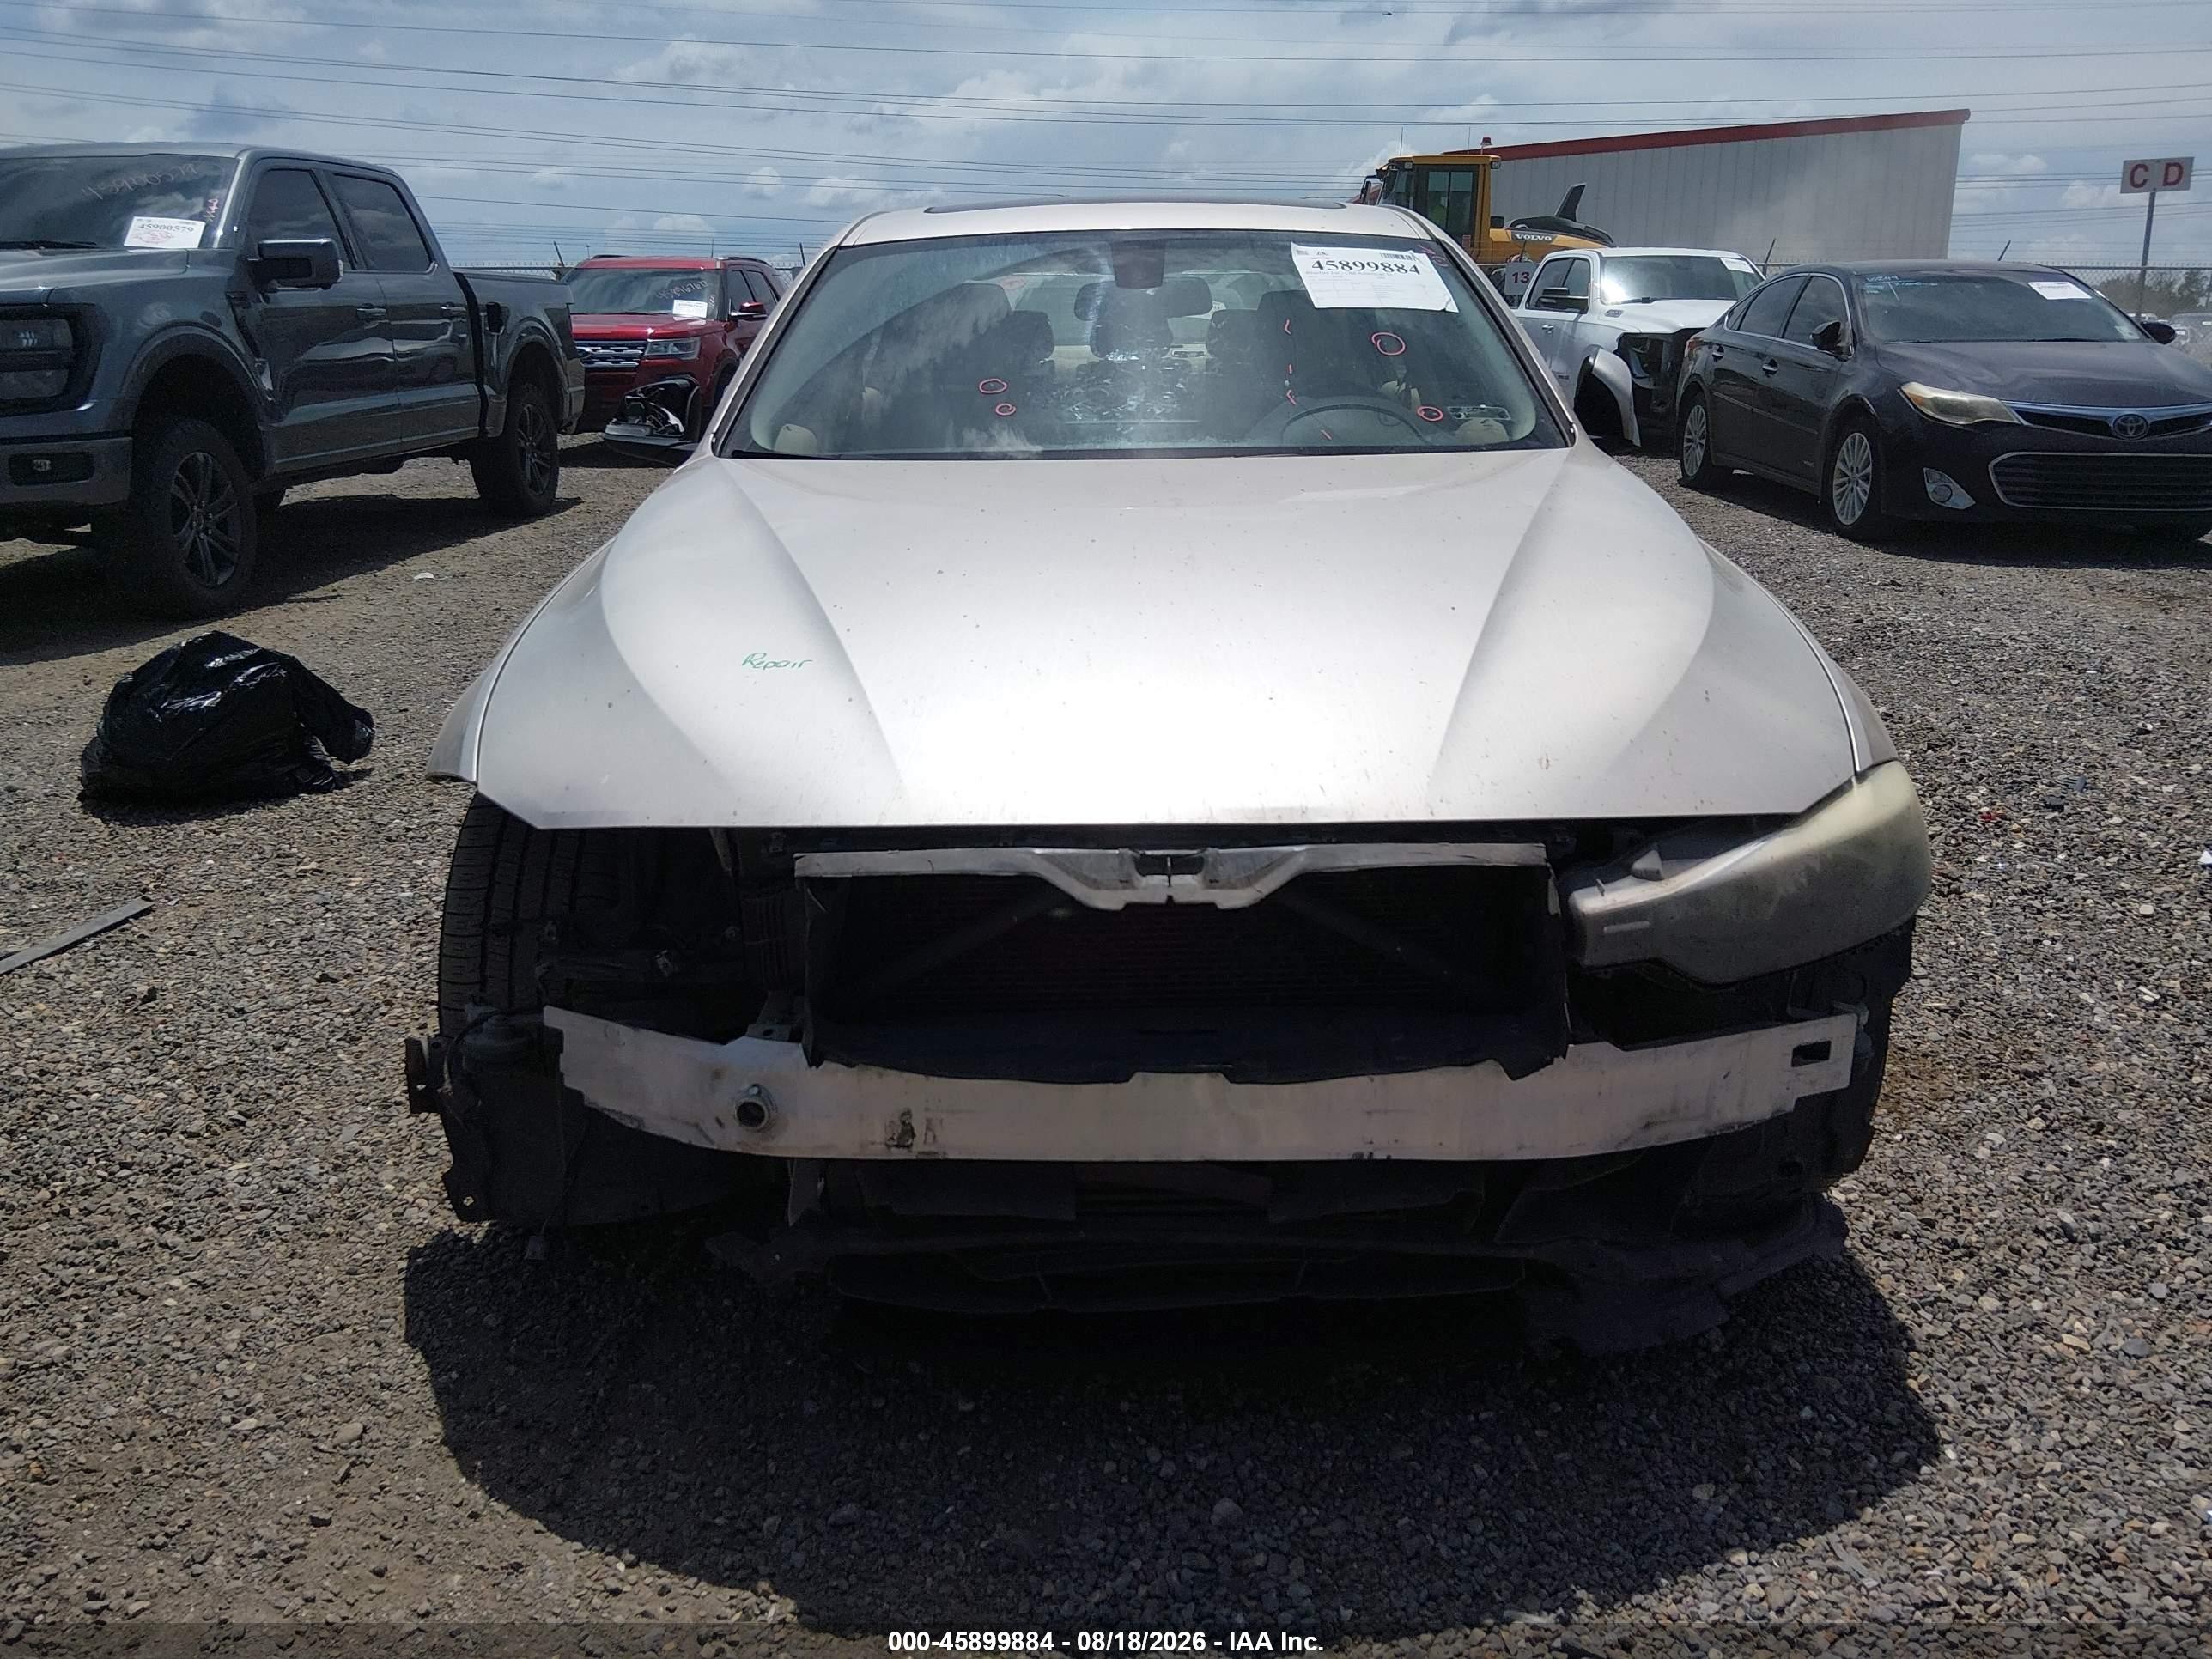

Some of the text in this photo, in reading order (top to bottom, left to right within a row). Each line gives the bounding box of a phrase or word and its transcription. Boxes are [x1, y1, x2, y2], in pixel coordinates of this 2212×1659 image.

[2130, 161, 2184, 188] C D
[1514, 233, 1553, 241] VOLVO
[1311, 259, 1421, 276] 45899884
[1511, 271, 1530, 283] 13
[741, 652, 813, 671] Repair
